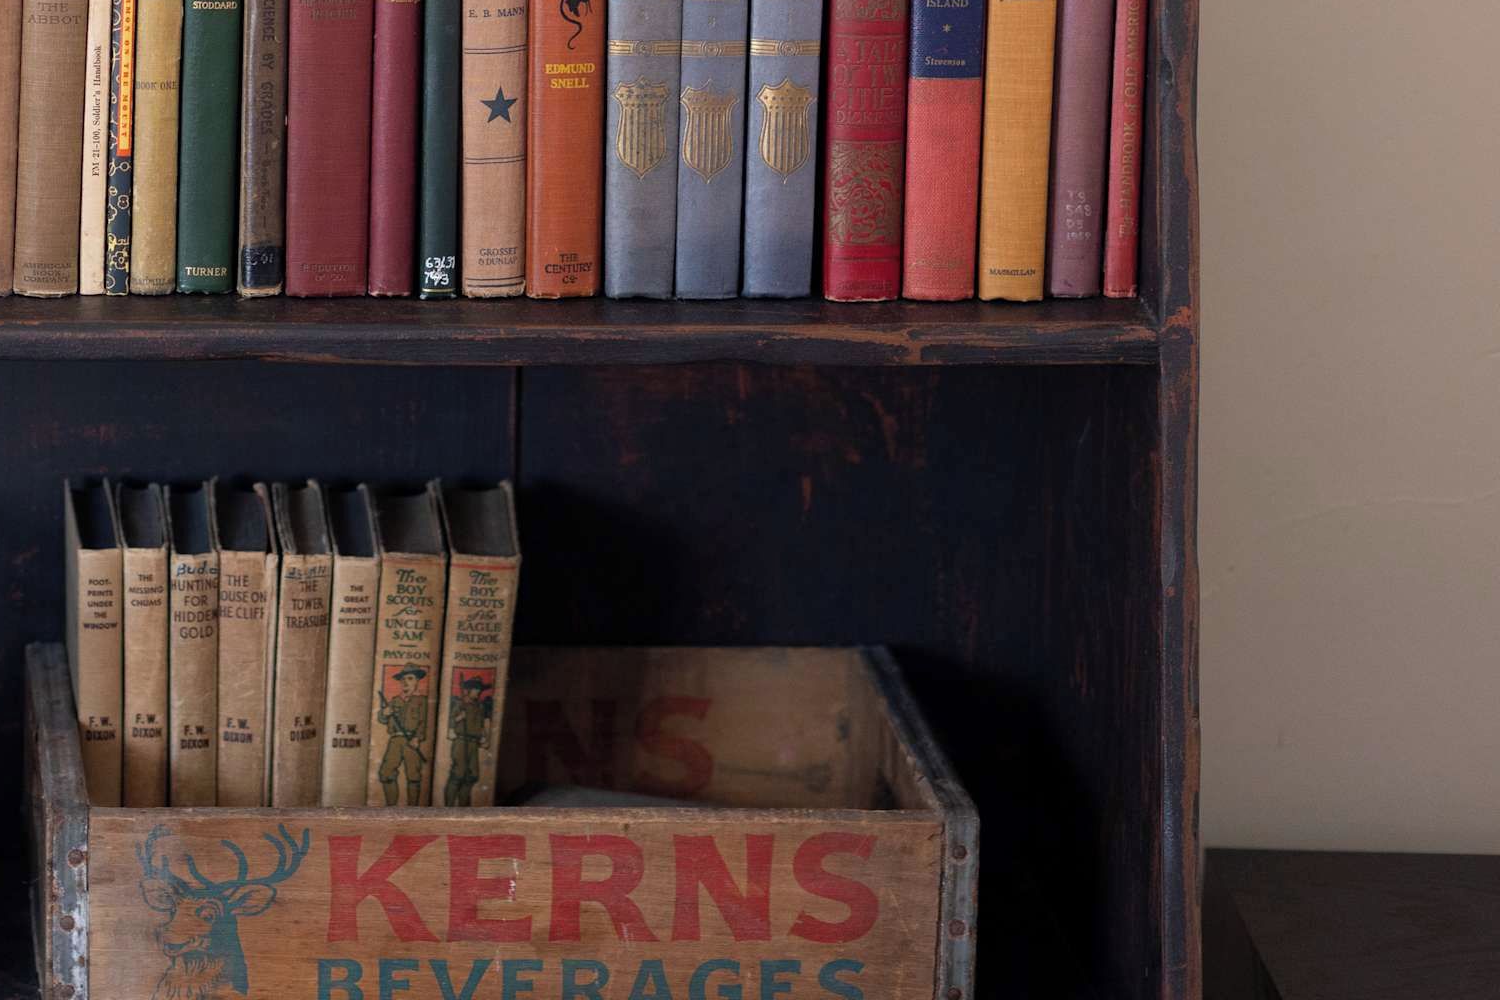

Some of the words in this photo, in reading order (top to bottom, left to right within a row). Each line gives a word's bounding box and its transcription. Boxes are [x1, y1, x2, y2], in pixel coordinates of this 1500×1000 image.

[37, 2, 69, 12] THE
[192, 0, 238, 10] STODDARD
[468, 9, 478, 18] E.
[497, 6, 525, 18] MANN
[27, 14, 82, 25] ABBOT
[124, 40, 131, 56] ON
[93, 45, 102, 87] Handbook
[261, 52, 275, 70] BY
[924, 55, 967, 67] Stevenson
[545, 63, 596, 75] EDMUND
[159, 81, 178, 90] ONE
[550, 76, 589, 89] SNELL
[92, 90, 101, 126] Soldier's
[91, 162, 100, 177] FM
[478, 247, 519, 257] GROSSET
[559, 253, 578, 262] THE
[486, 256, 518, 266] DUNLAP
[544, 261, 593, 274] CENTURY
[185, 266, 229, 278] TURNER
[138, 573, 153, 582] THE
[227, 574, 249, 587] THE
[396, 567, 428, 584] The
[128, 585, 164, 594] MISSING
[171, 578, 219, 592] HUNTING
[299, 580, 319, 593] THE
[396, 583, 427, 595] BOY
[470, 585, 500, 598] BOY
[130, 598, 162, 607] CHUMS
[183, 595, 208, 607] FOR
[221, 589, 248, 603] OUSE
[250, 590, 267, 604] ON
[385, 595, 435, 607] SCOUTS
[87, 600, 114, 608] UNDER
[291, 598, 324, 611] TOWER
[339, 605, 372, 614] AIRPORT
[458, 597, 506, 610] SCOUTS
[235, 606, 266, 620] CLIFF
[390, 604, 423, 618] for
[384, 618, 433, 632] UNCLE
[456, 620, 502, 633] EAGLE
[179, 626, 214, 640] GOLD
[391, 630, 424, 642] SAM
[455, 633, 500, 645] PATROL
[382, 649, 432, 661] PAYSON
[453, 651, 500, 663] PAYSON
[135, 713, 146, 725] F.
[85, 729, 116, 742] DIXON
[132, 726, 163, 739] DIXON
[335, 723, 346, 735] F.
[180, 737, 210, 750] DIXON
[222, 731, 253, 744] DIXON
[331, 736, 362, 749] DIXON
[325, 829, 882, 944] KERNS
[316, 956, 867, 1000] BEVERAGES
